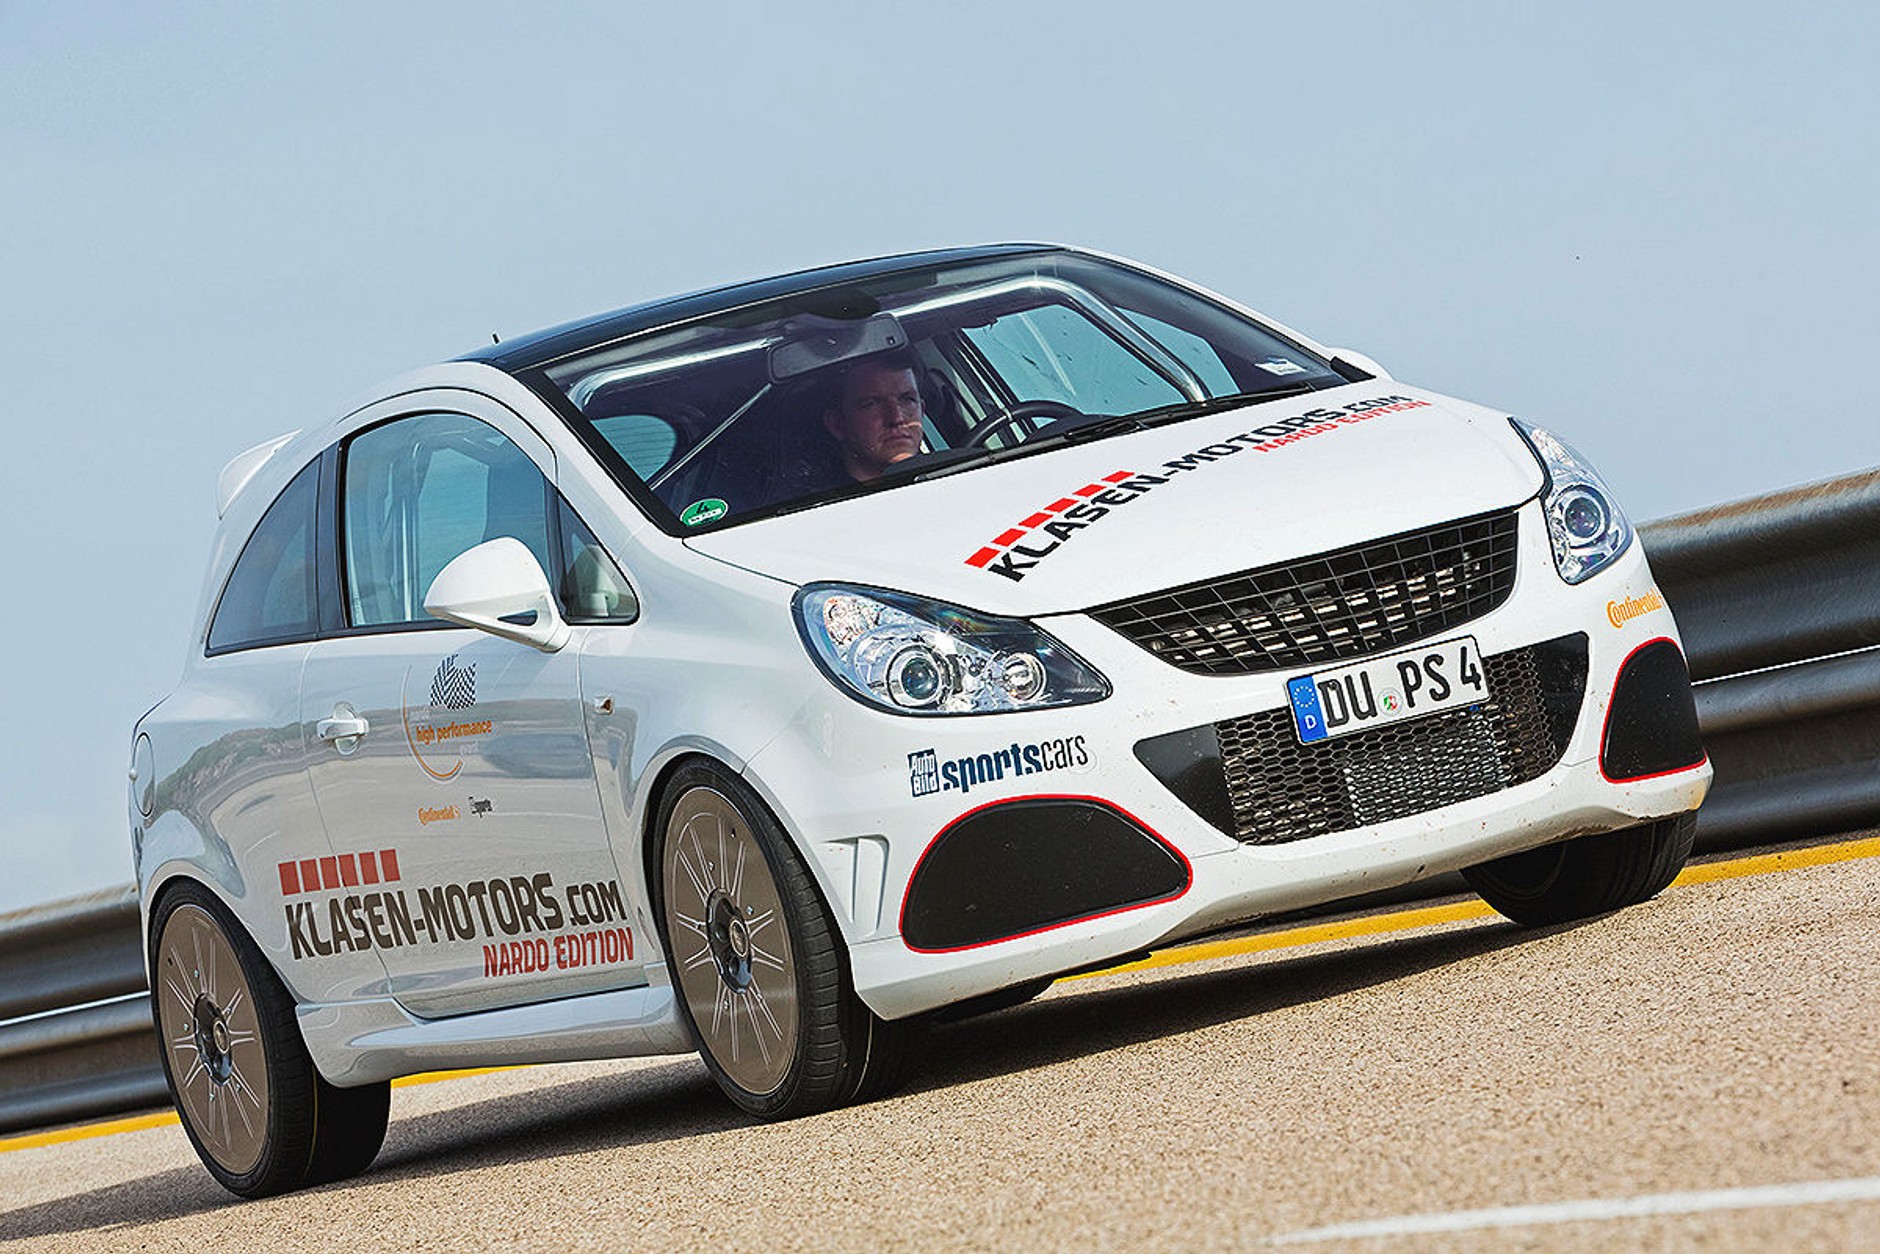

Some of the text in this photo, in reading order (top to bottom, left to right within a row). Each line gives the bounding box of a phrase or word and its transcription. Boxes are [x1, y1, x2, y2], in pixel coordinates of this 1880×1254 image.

[1252, 423, 1339, 453] NARDO
[1607, 588, 1660, 628] Continental
[1317, 645, 1482, 729] DU PS 4
[416, 720, 492, 746] high performance
[1305, 714, 1317, 730] D
[285, 872, 627, 960] KLASEN-MOTORS.COM
[482, 927, 634, 978] NARDO EDITION
